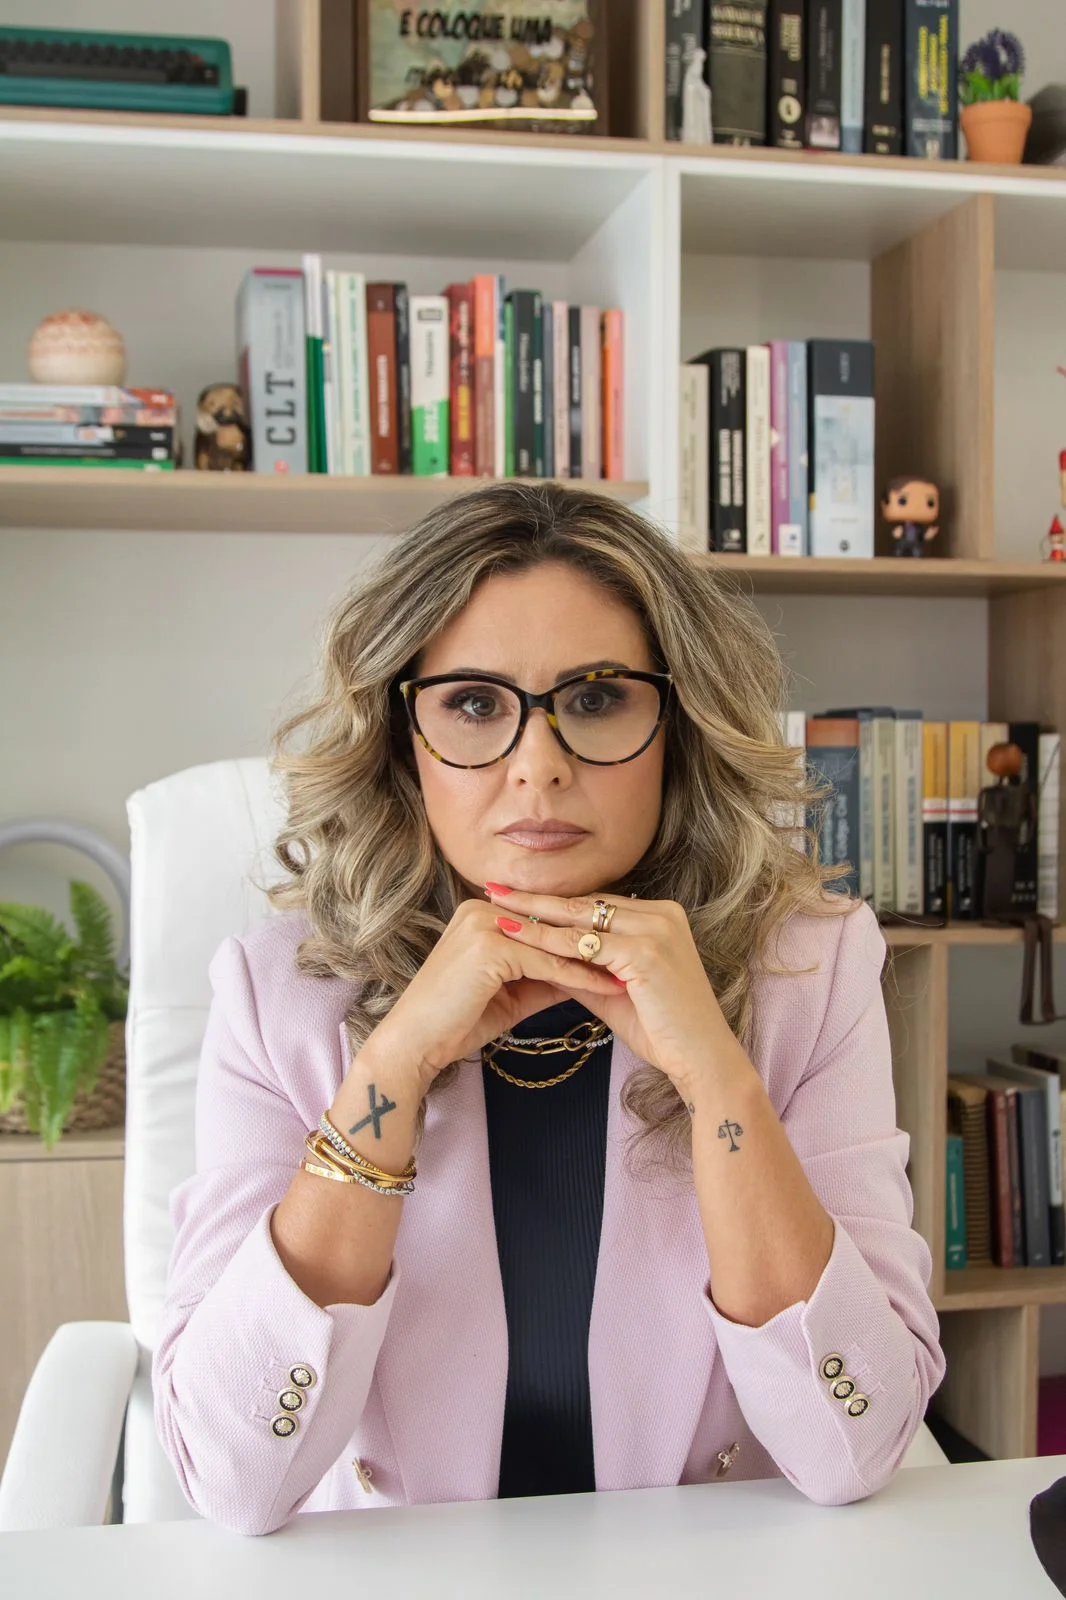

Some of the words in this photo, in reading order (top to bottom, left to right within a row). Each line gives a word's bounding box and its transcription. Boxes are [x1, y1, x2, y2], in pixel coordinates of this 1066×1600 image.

[399, 10, 410, 37] E
[416, 11, 505, 39] COLOQUE
[510, 15, 553, 43] UMA
[264, 371, 297, 447] CLT
